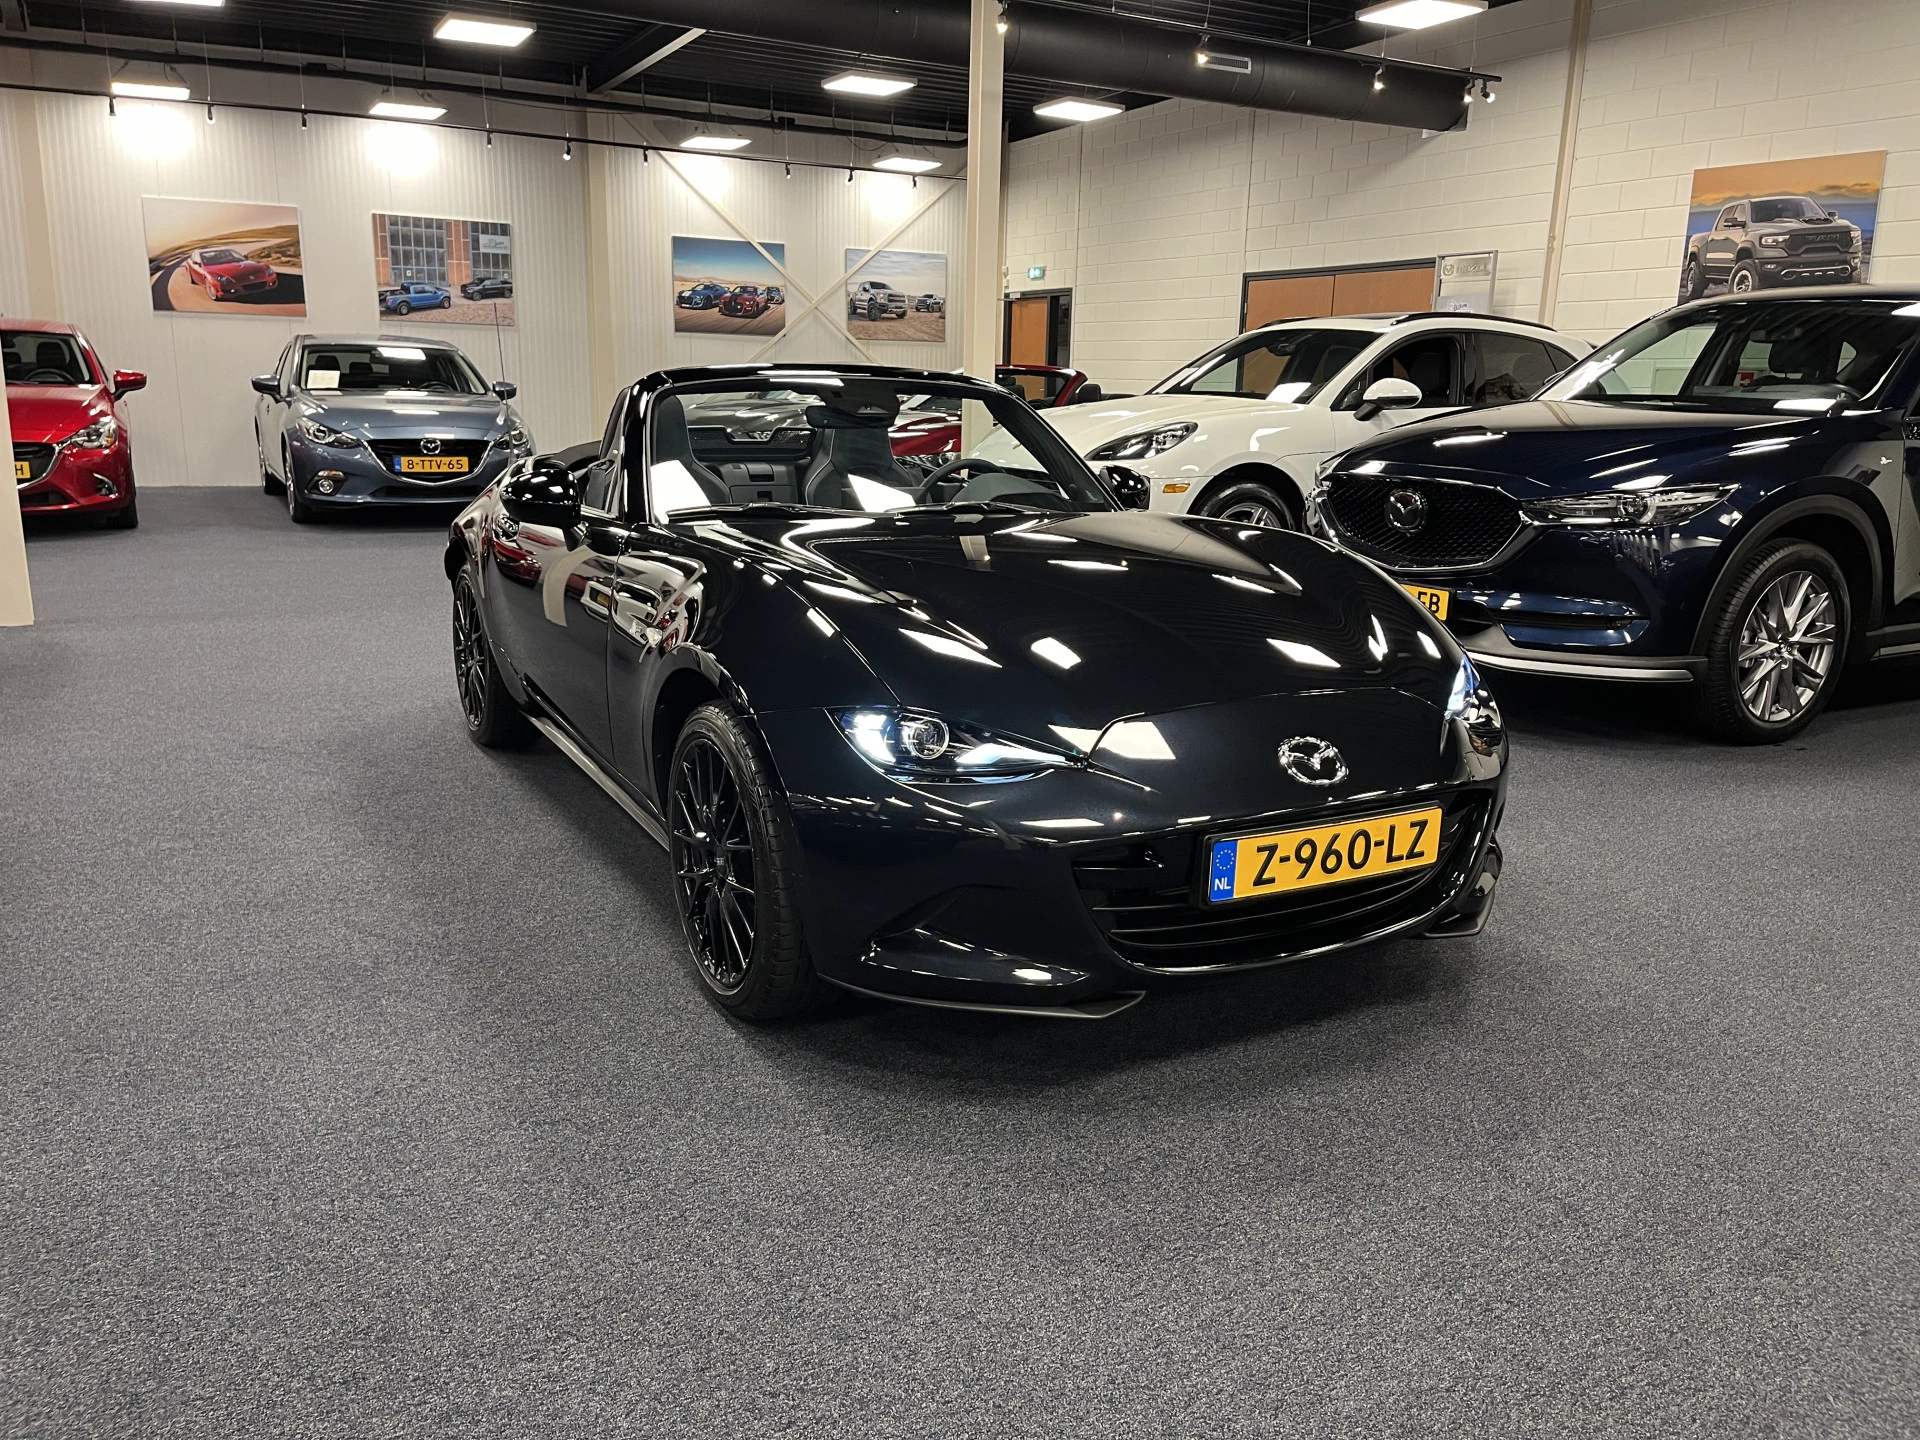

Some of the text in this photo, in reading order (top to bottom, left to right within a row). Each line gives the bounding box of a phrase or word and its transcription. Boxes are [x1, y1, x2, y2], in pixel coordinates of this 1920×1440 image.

[406, 459, 464, 470] 8-TTV-65
[1252, 819, 1429, 887] Z-960-LZ
[1214, 877, 1232, 891] NL
